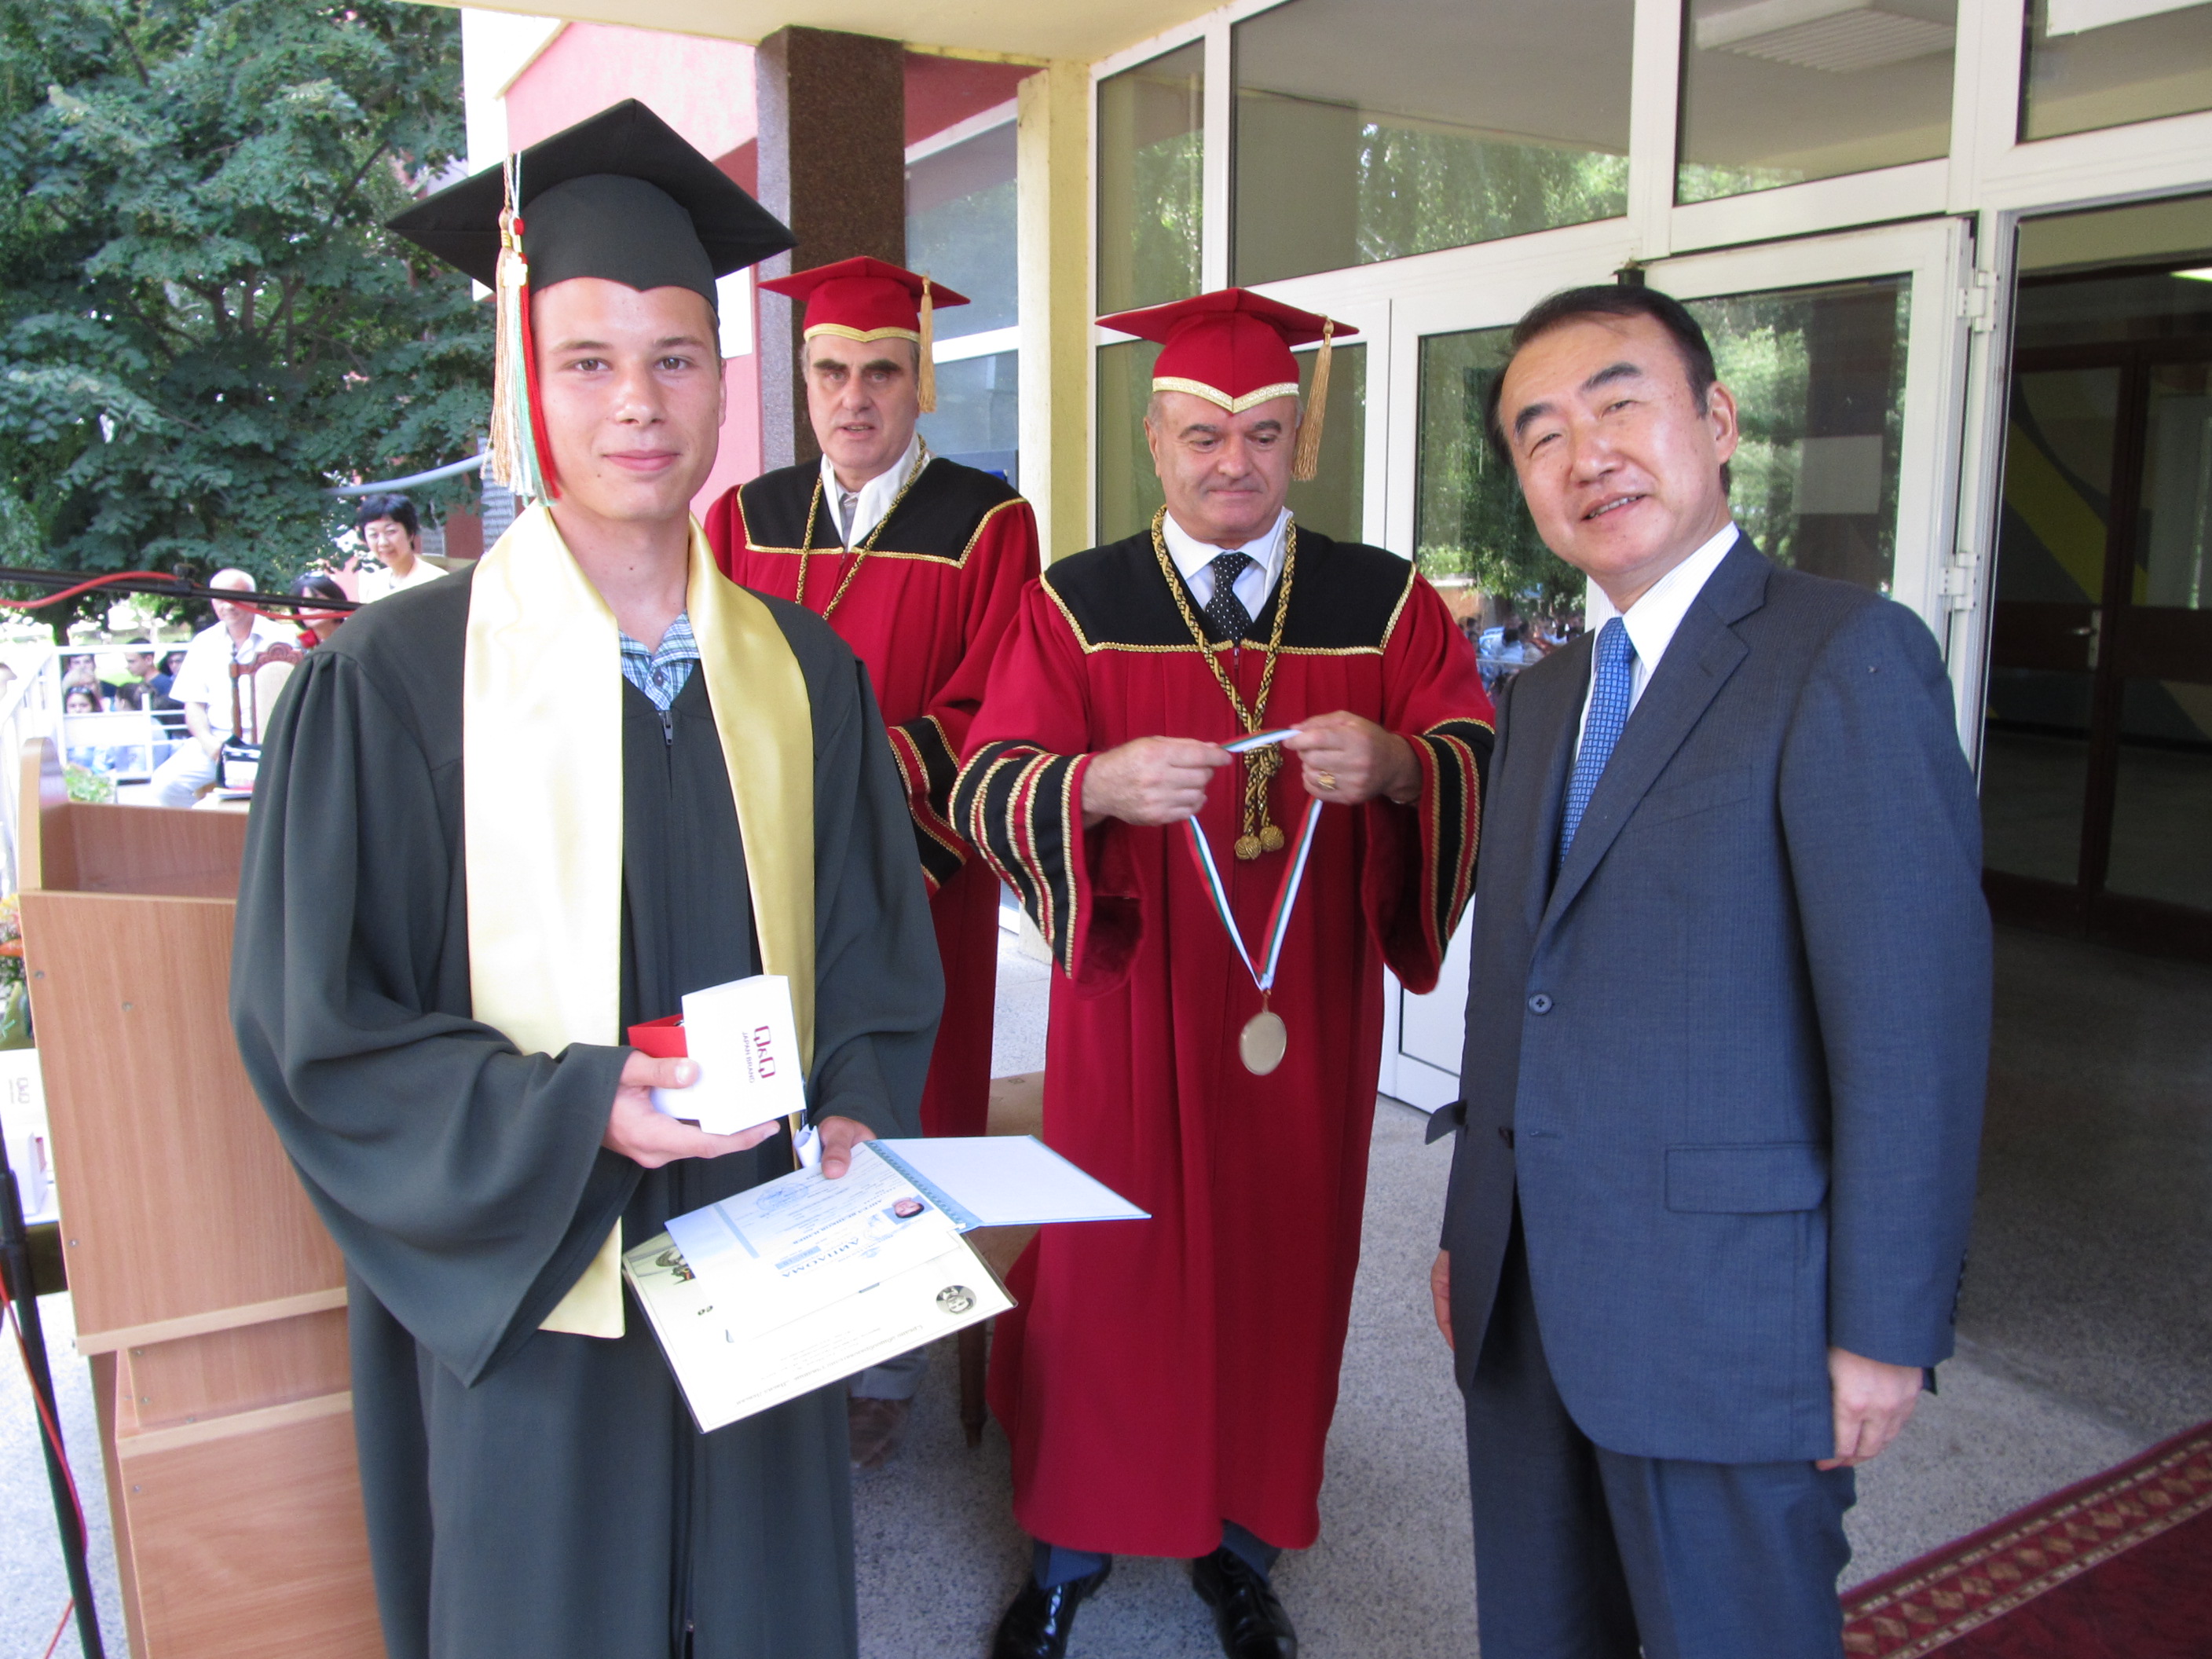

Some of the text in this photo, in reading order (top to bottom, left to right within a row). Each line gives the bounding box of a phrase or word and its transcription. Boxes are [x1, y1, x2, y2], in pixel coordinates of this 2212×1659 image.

[742, 1031, 755, 1083] JAPAN BRAND
[753, 1025, 775, 1079] Q&Q
[782, 1237, 859, 1278] ДИПЛОМА
